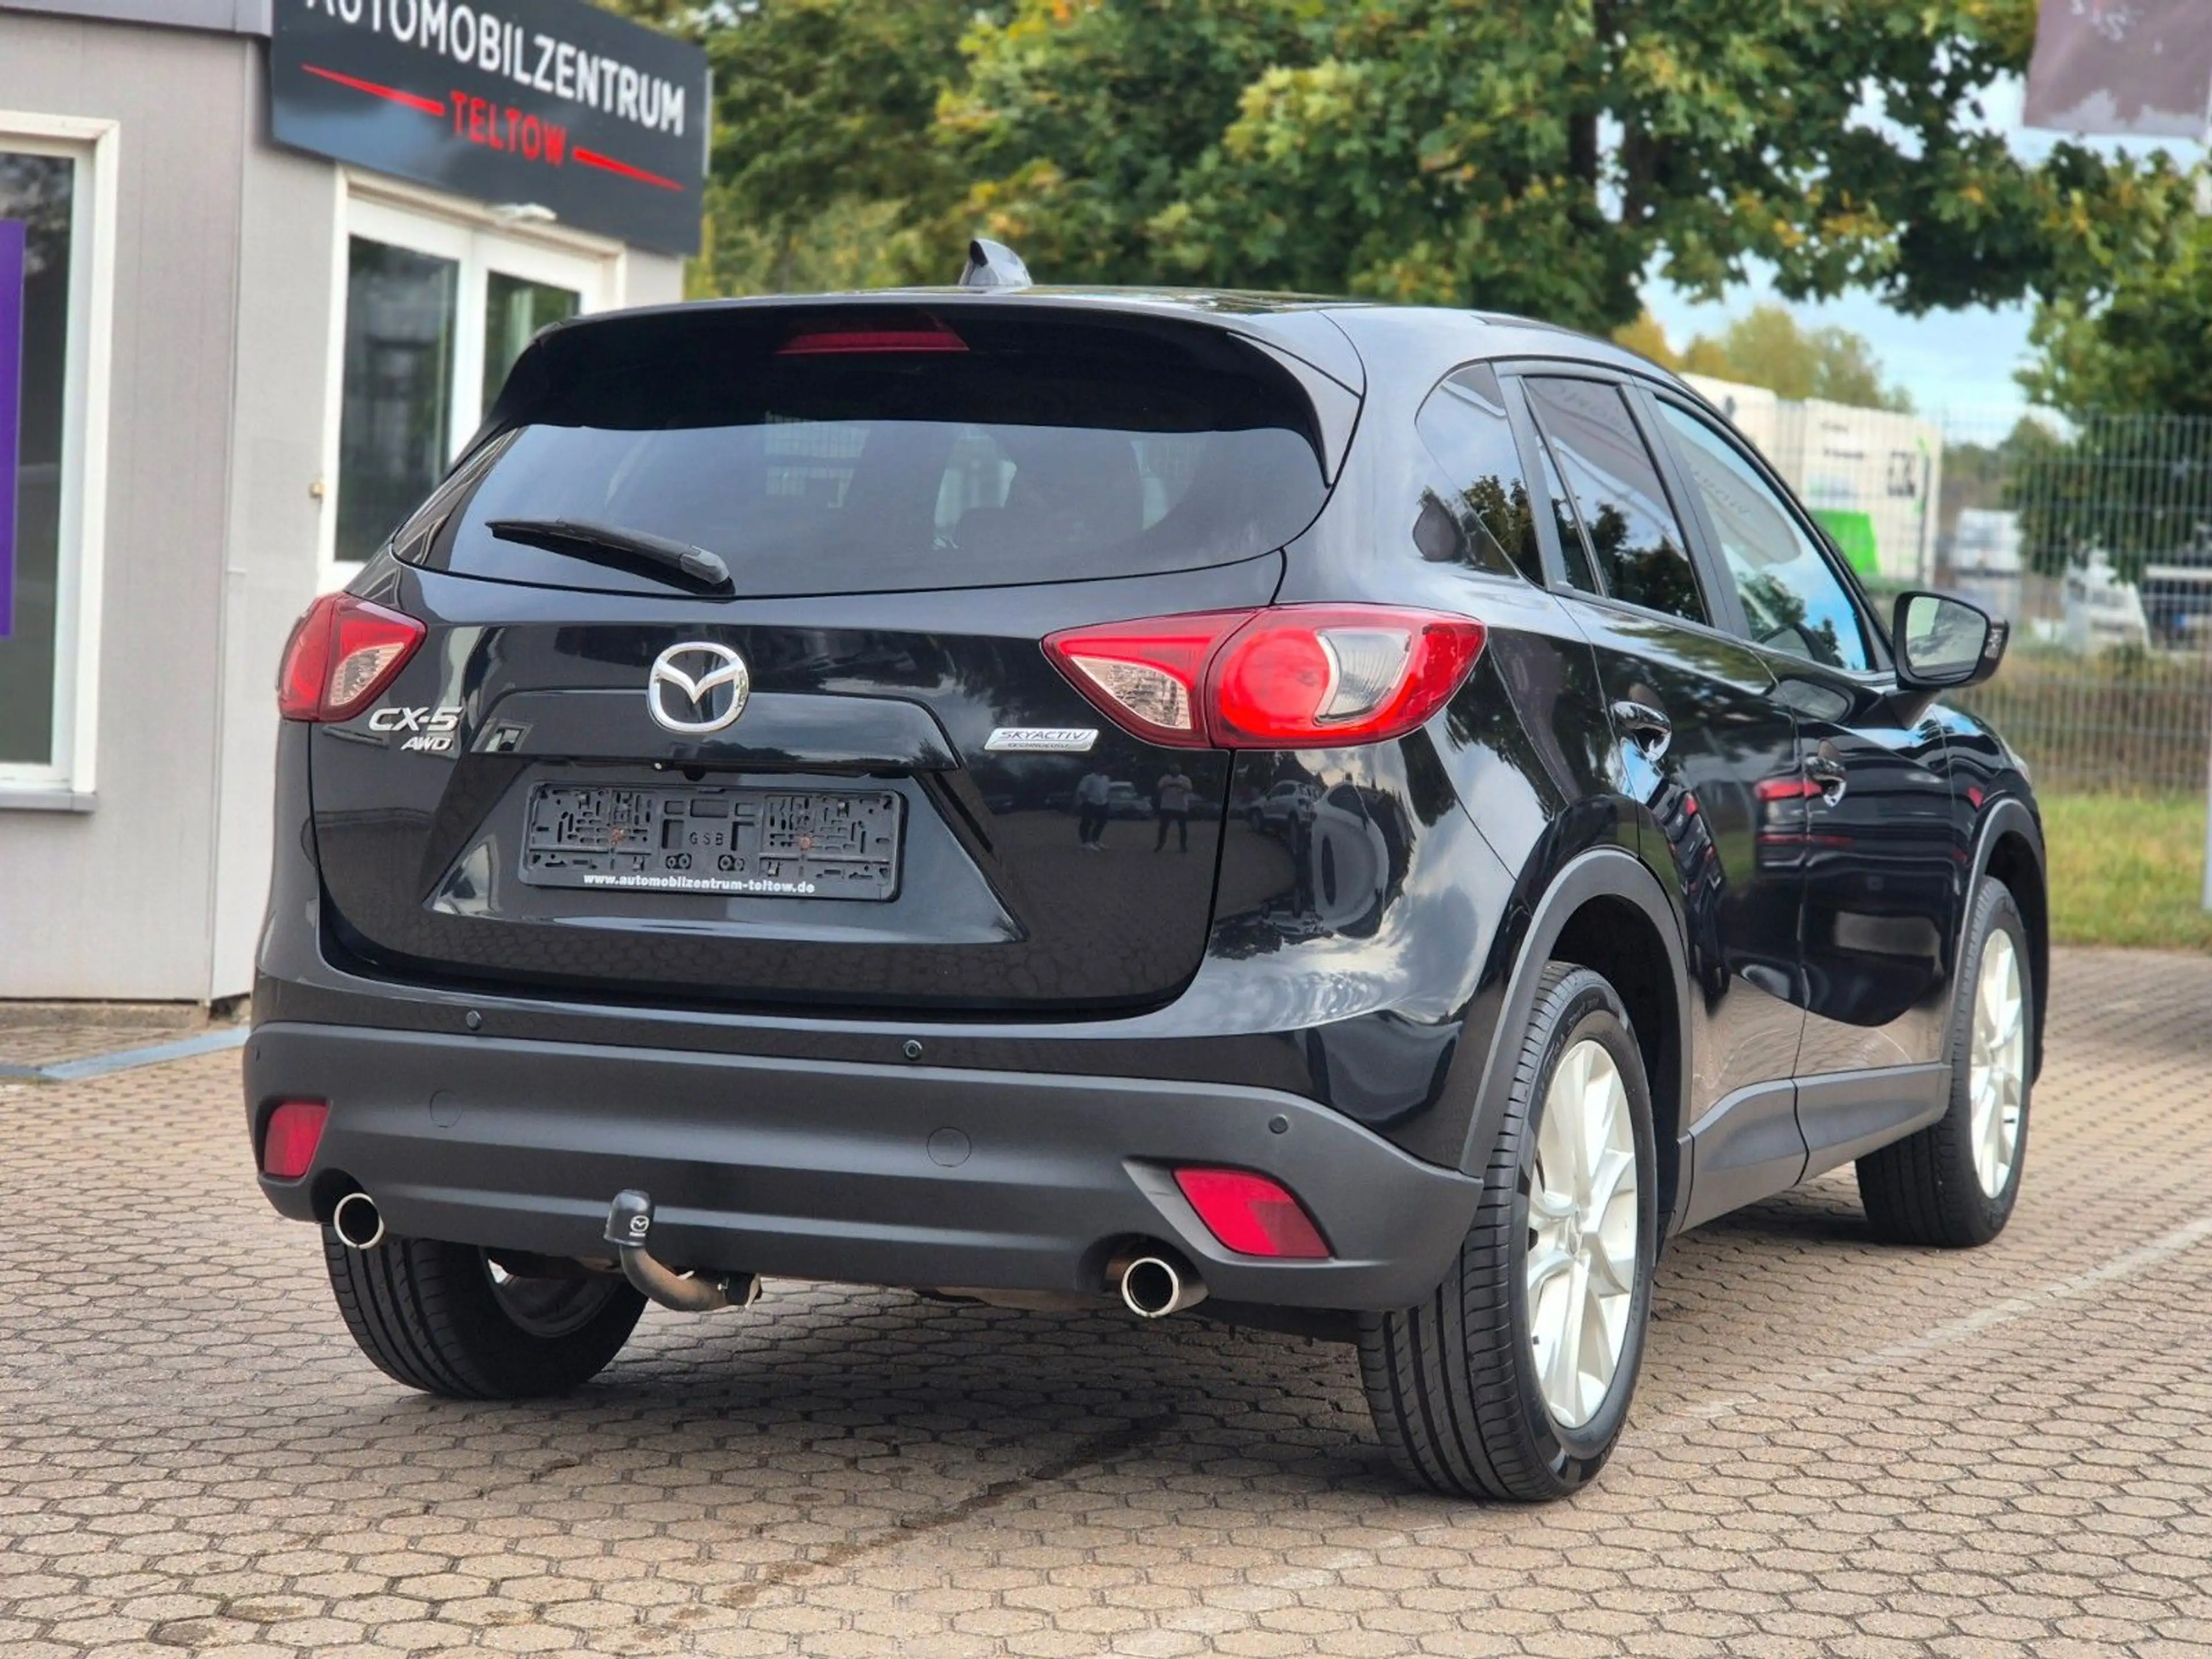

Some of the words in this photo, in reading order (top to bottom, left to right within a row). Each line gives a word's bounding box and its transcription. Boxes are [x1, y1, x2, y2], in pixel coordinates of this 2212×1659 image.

[306, 0, 685, 137] OMOBILZENTRUM
[450, 90, 567, 167] TELTOW
[369, 707, 463, 731] CX-5
[400, 737, 452, 751] AWD
[1001, 731, 1085, 740] SKYACTIV
[583, 873, 816, 893] www.automobilzentrum-teltow.de
